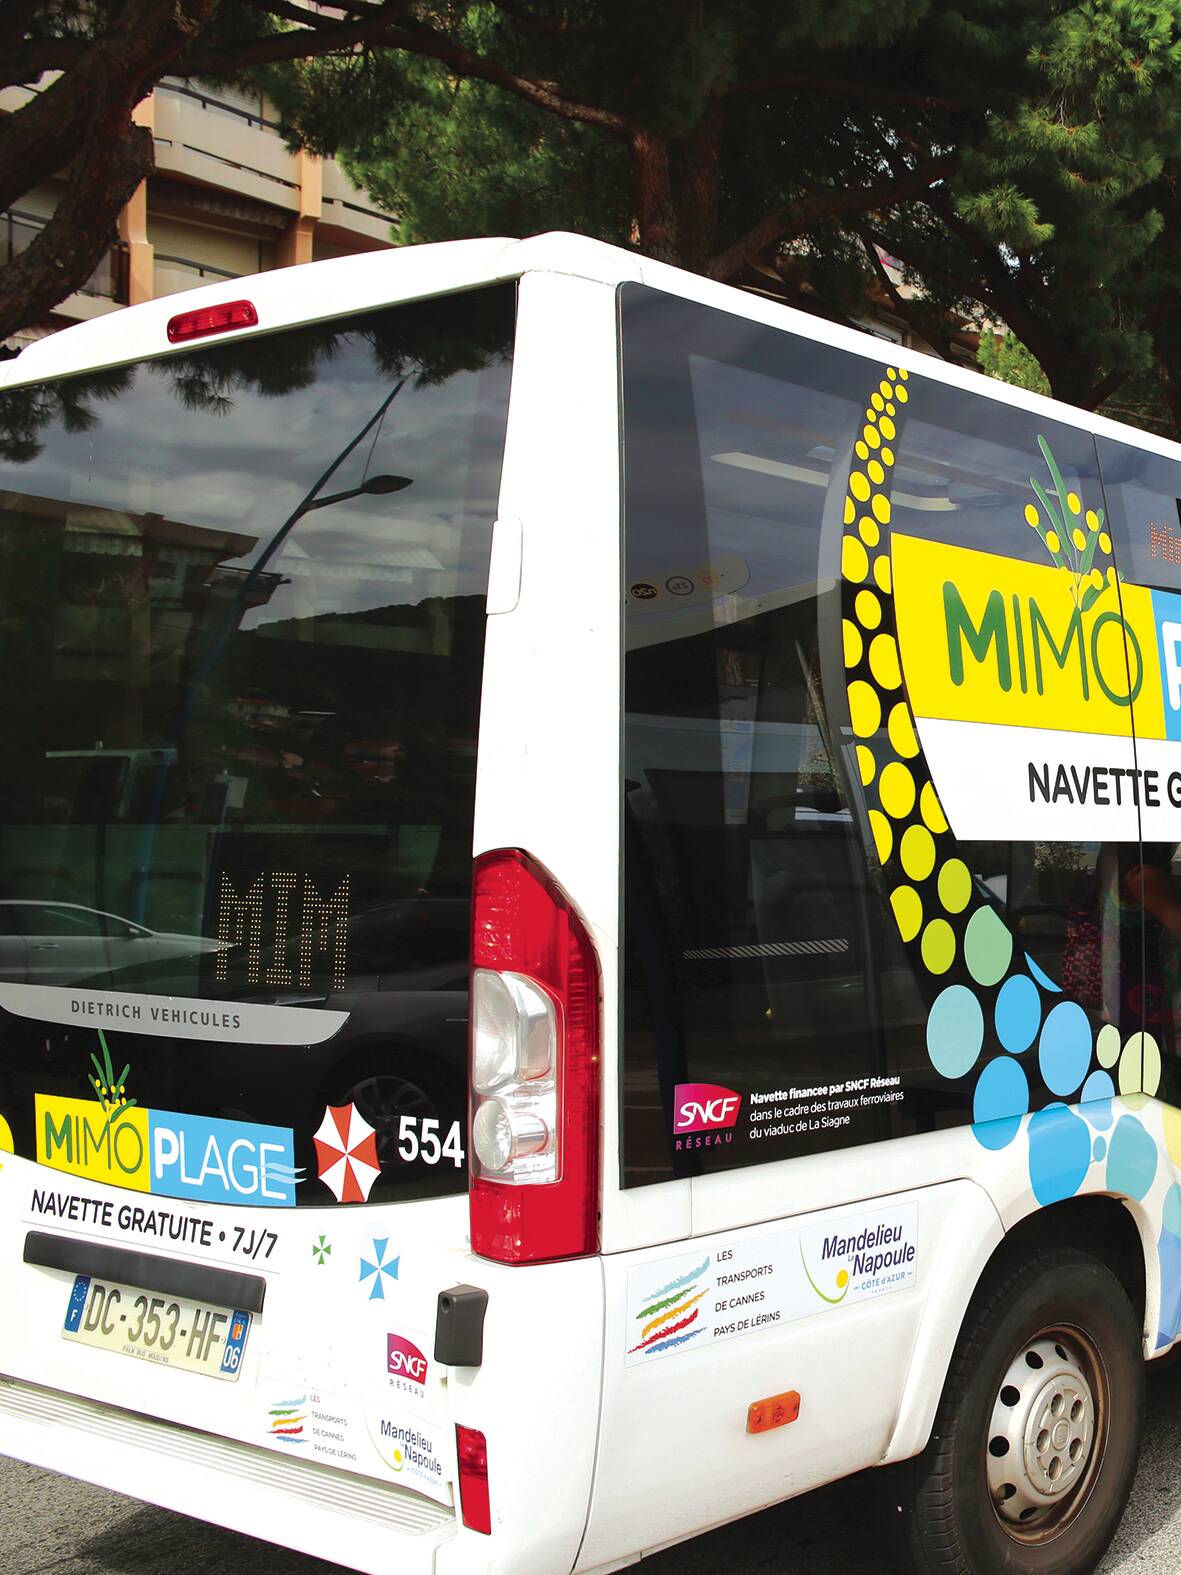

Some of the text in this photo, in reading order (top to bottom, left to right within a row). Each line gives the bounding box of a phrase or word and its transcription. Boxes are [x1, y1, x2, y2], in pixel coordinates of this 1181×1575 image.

[1028, 761, 1160, 808] NAVETTE
[216, 871, 350, 990] MIM
[71, 1000, 142, 1020] DIETRICH
[750, 1089, 788, 1105] Navette
[829, 1083, 844, 1096] par
[845, 1078, 869, 1092] SNCF
[870, 1075, 900, 1089] Réseau
[677, 1096, 738, 1127] SNCF
[750, 1090, 904, 1122] dans le cadre des travaux ferroviaires
[749, 1114, 851, 1139] du viaduc de La Siagne
[398, 1116, 465, 1168] 554
[676, 1133, 733, 1150] RÉSEAU
[31, 1189, 278, 1260] NAVETTE GRATUITE 7J/7
[717, 1250, 733, 1262] LES
[822, 1223, 903, 1260] Mandelieu
[852, 1242, 915, 1277] Napoule
[717, 1264, 773, 1288] TRANSPORTS
[69, 1310, 77, 1321] F
[715, 1291, 765, 1312] DE CANNES
[713, 1310, 780, 1338] PAYS DE LÉRINS
[223, 1345, 240, 1369] 06
[389, 1350, 426, 1377] SNCF
[312, 1411, 347, 1427] TRANSPORTS
[380, 1420, 432, 1453] Mandelieu
[405, 1444, 441, 1475] Napoule
